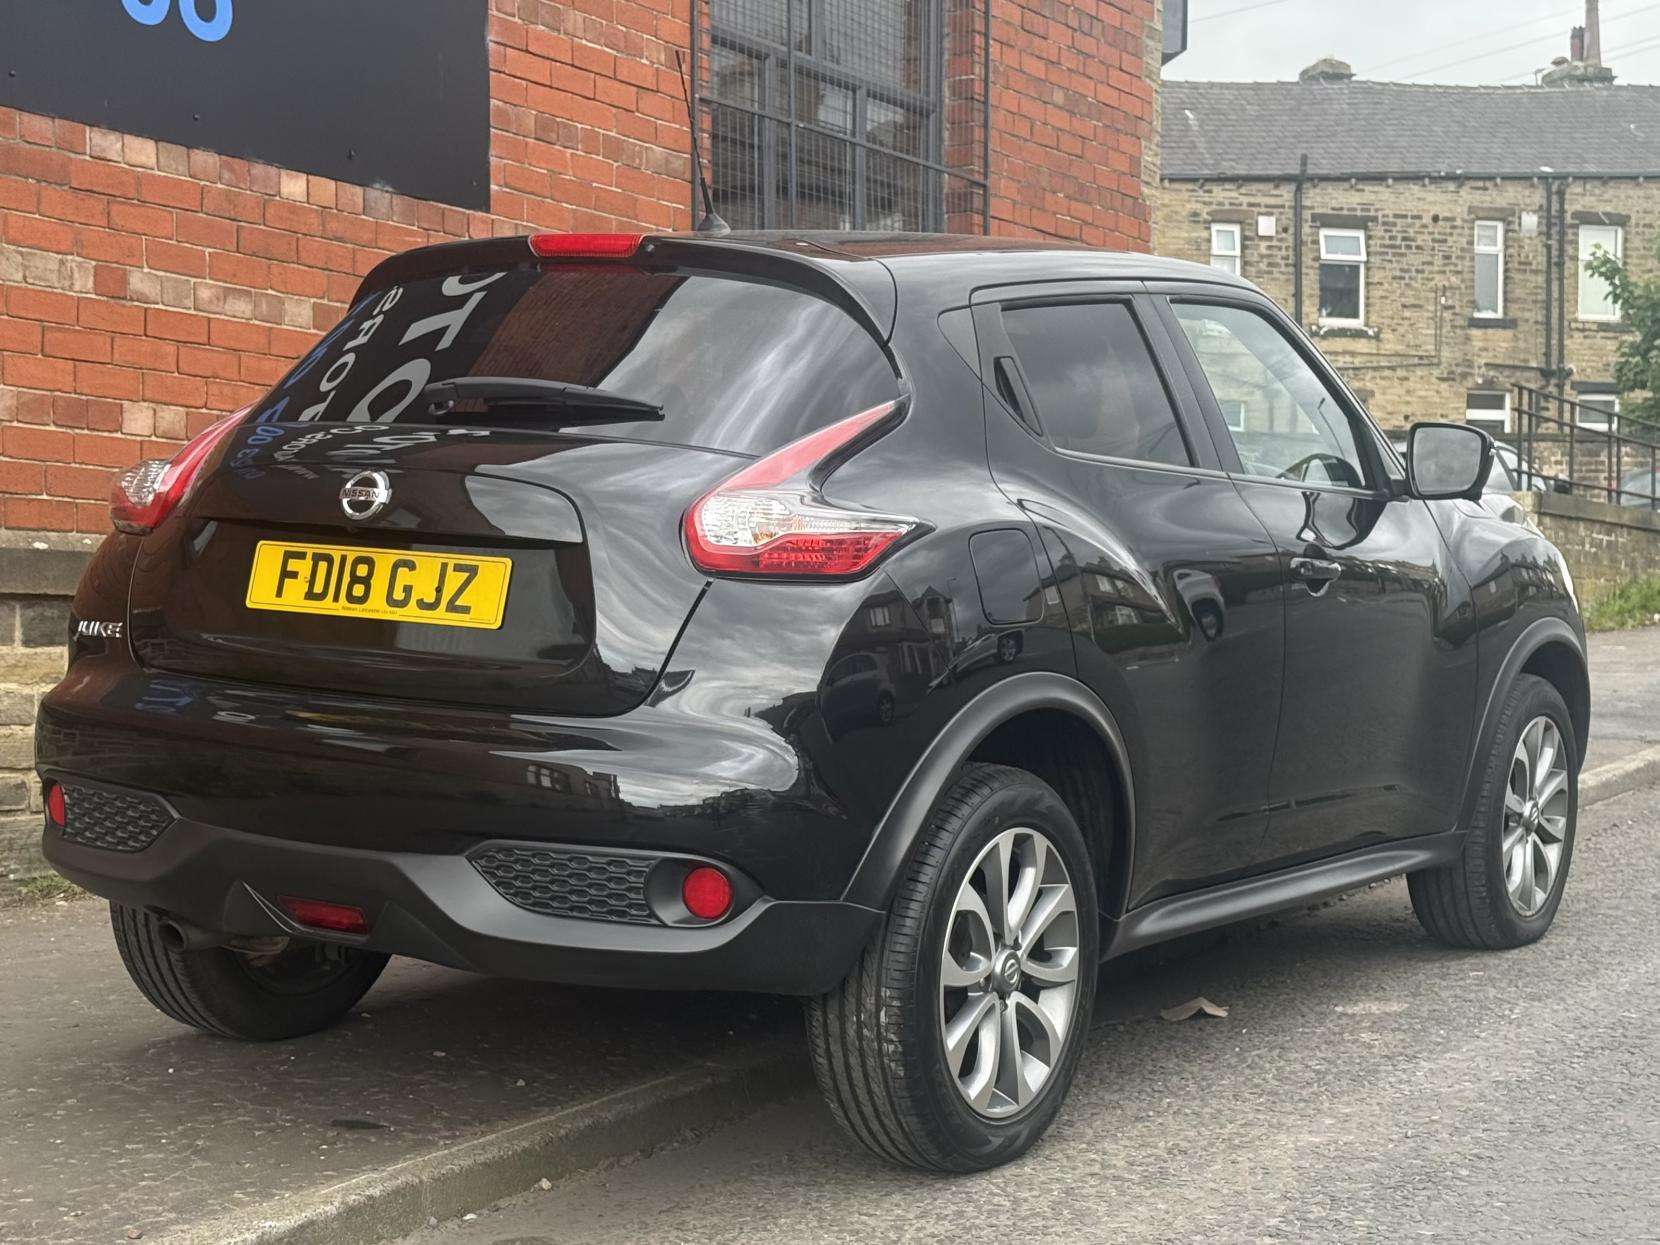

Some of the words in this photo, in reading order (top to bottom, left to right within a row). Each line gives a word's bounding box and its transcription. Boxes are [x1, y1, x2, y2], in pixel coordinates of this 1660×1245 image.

[343, 489, 380, 499] NISSAN
[275, 550, 376, 605] FD18
[386, 558, 479, 615] GJZ
[73, 620, 123, 641] JUKE
